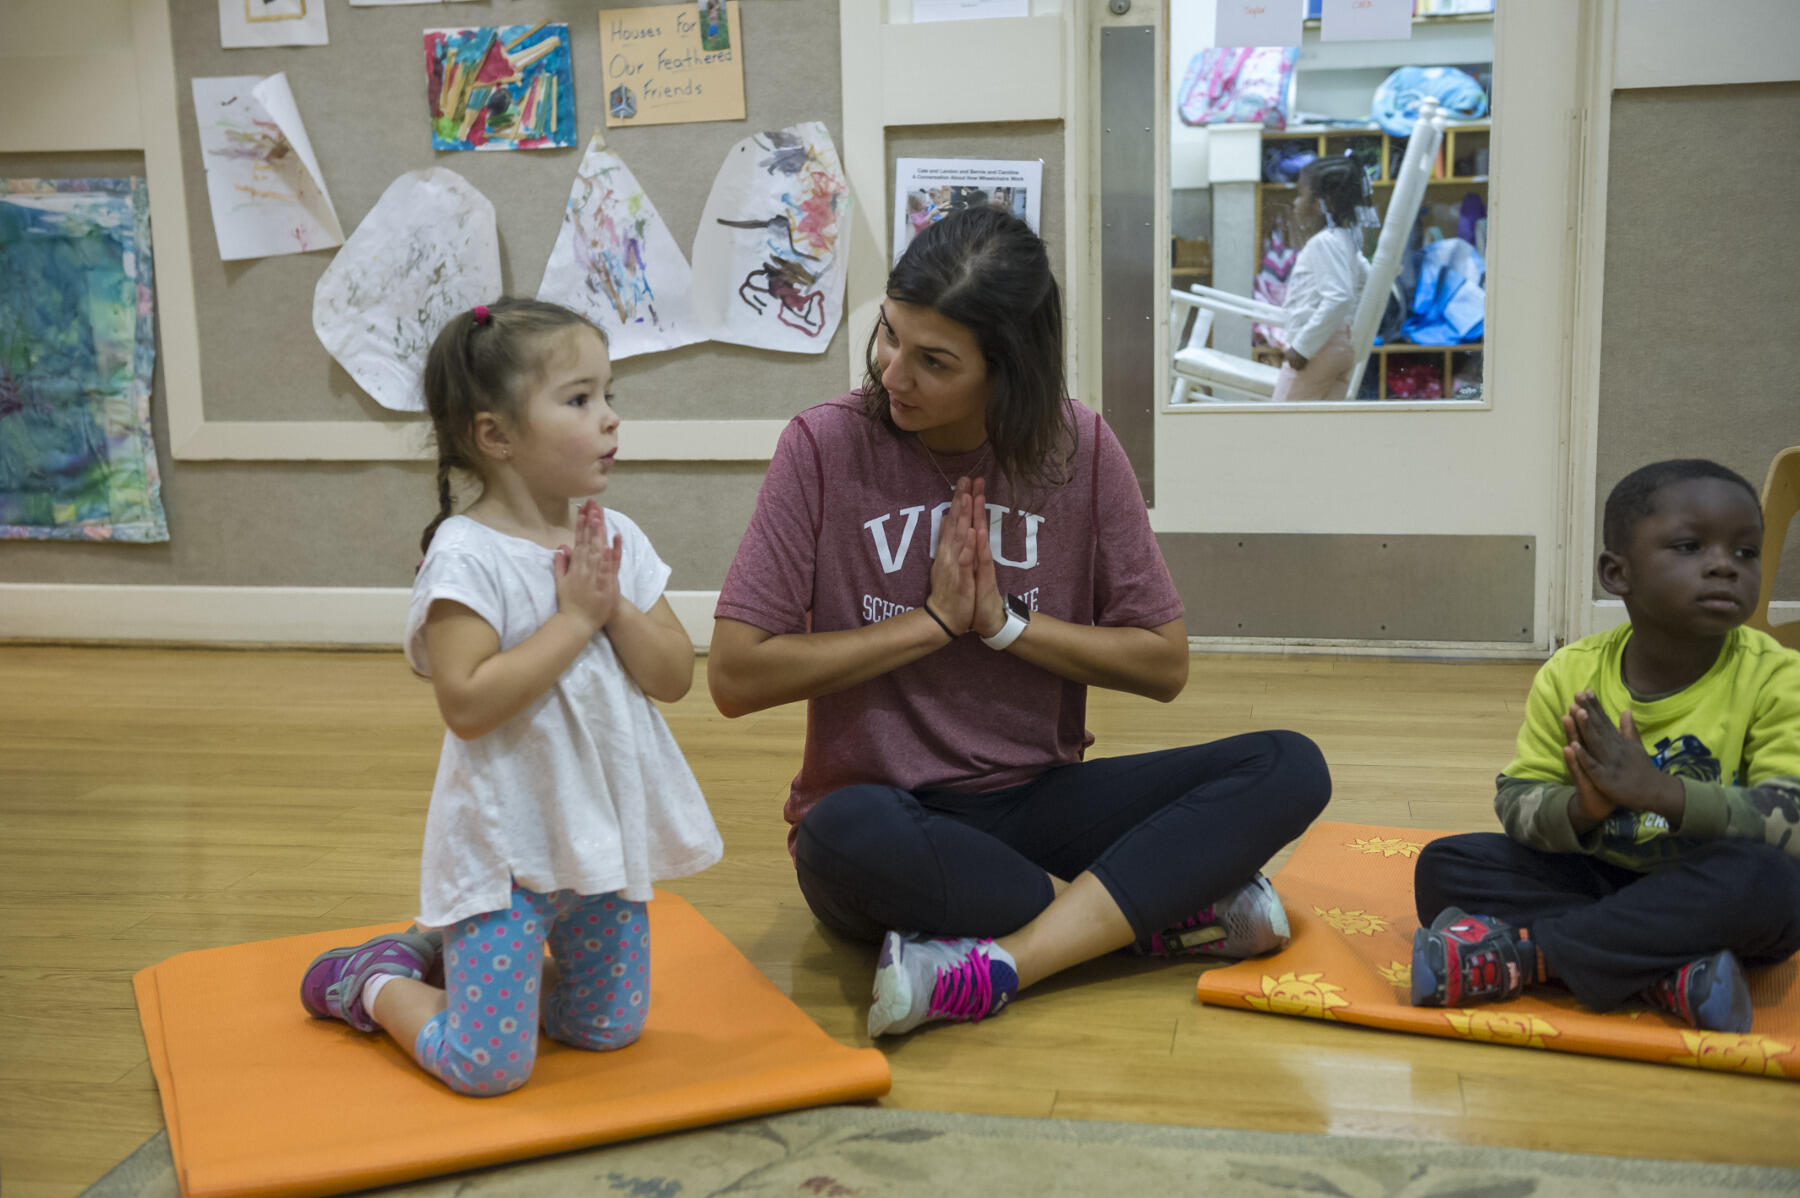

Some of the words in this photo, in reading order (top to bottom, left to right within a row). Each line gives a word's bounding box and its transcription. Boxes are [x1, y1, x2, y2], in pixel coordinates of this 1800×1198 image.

[610, 19, 662, 42] Houses
[676, 11, 697, 33] For
[608, 53, 644, 79] Our
[657, 47, 733, 72] Feathered
[643, 78, 703, 100] Friends
